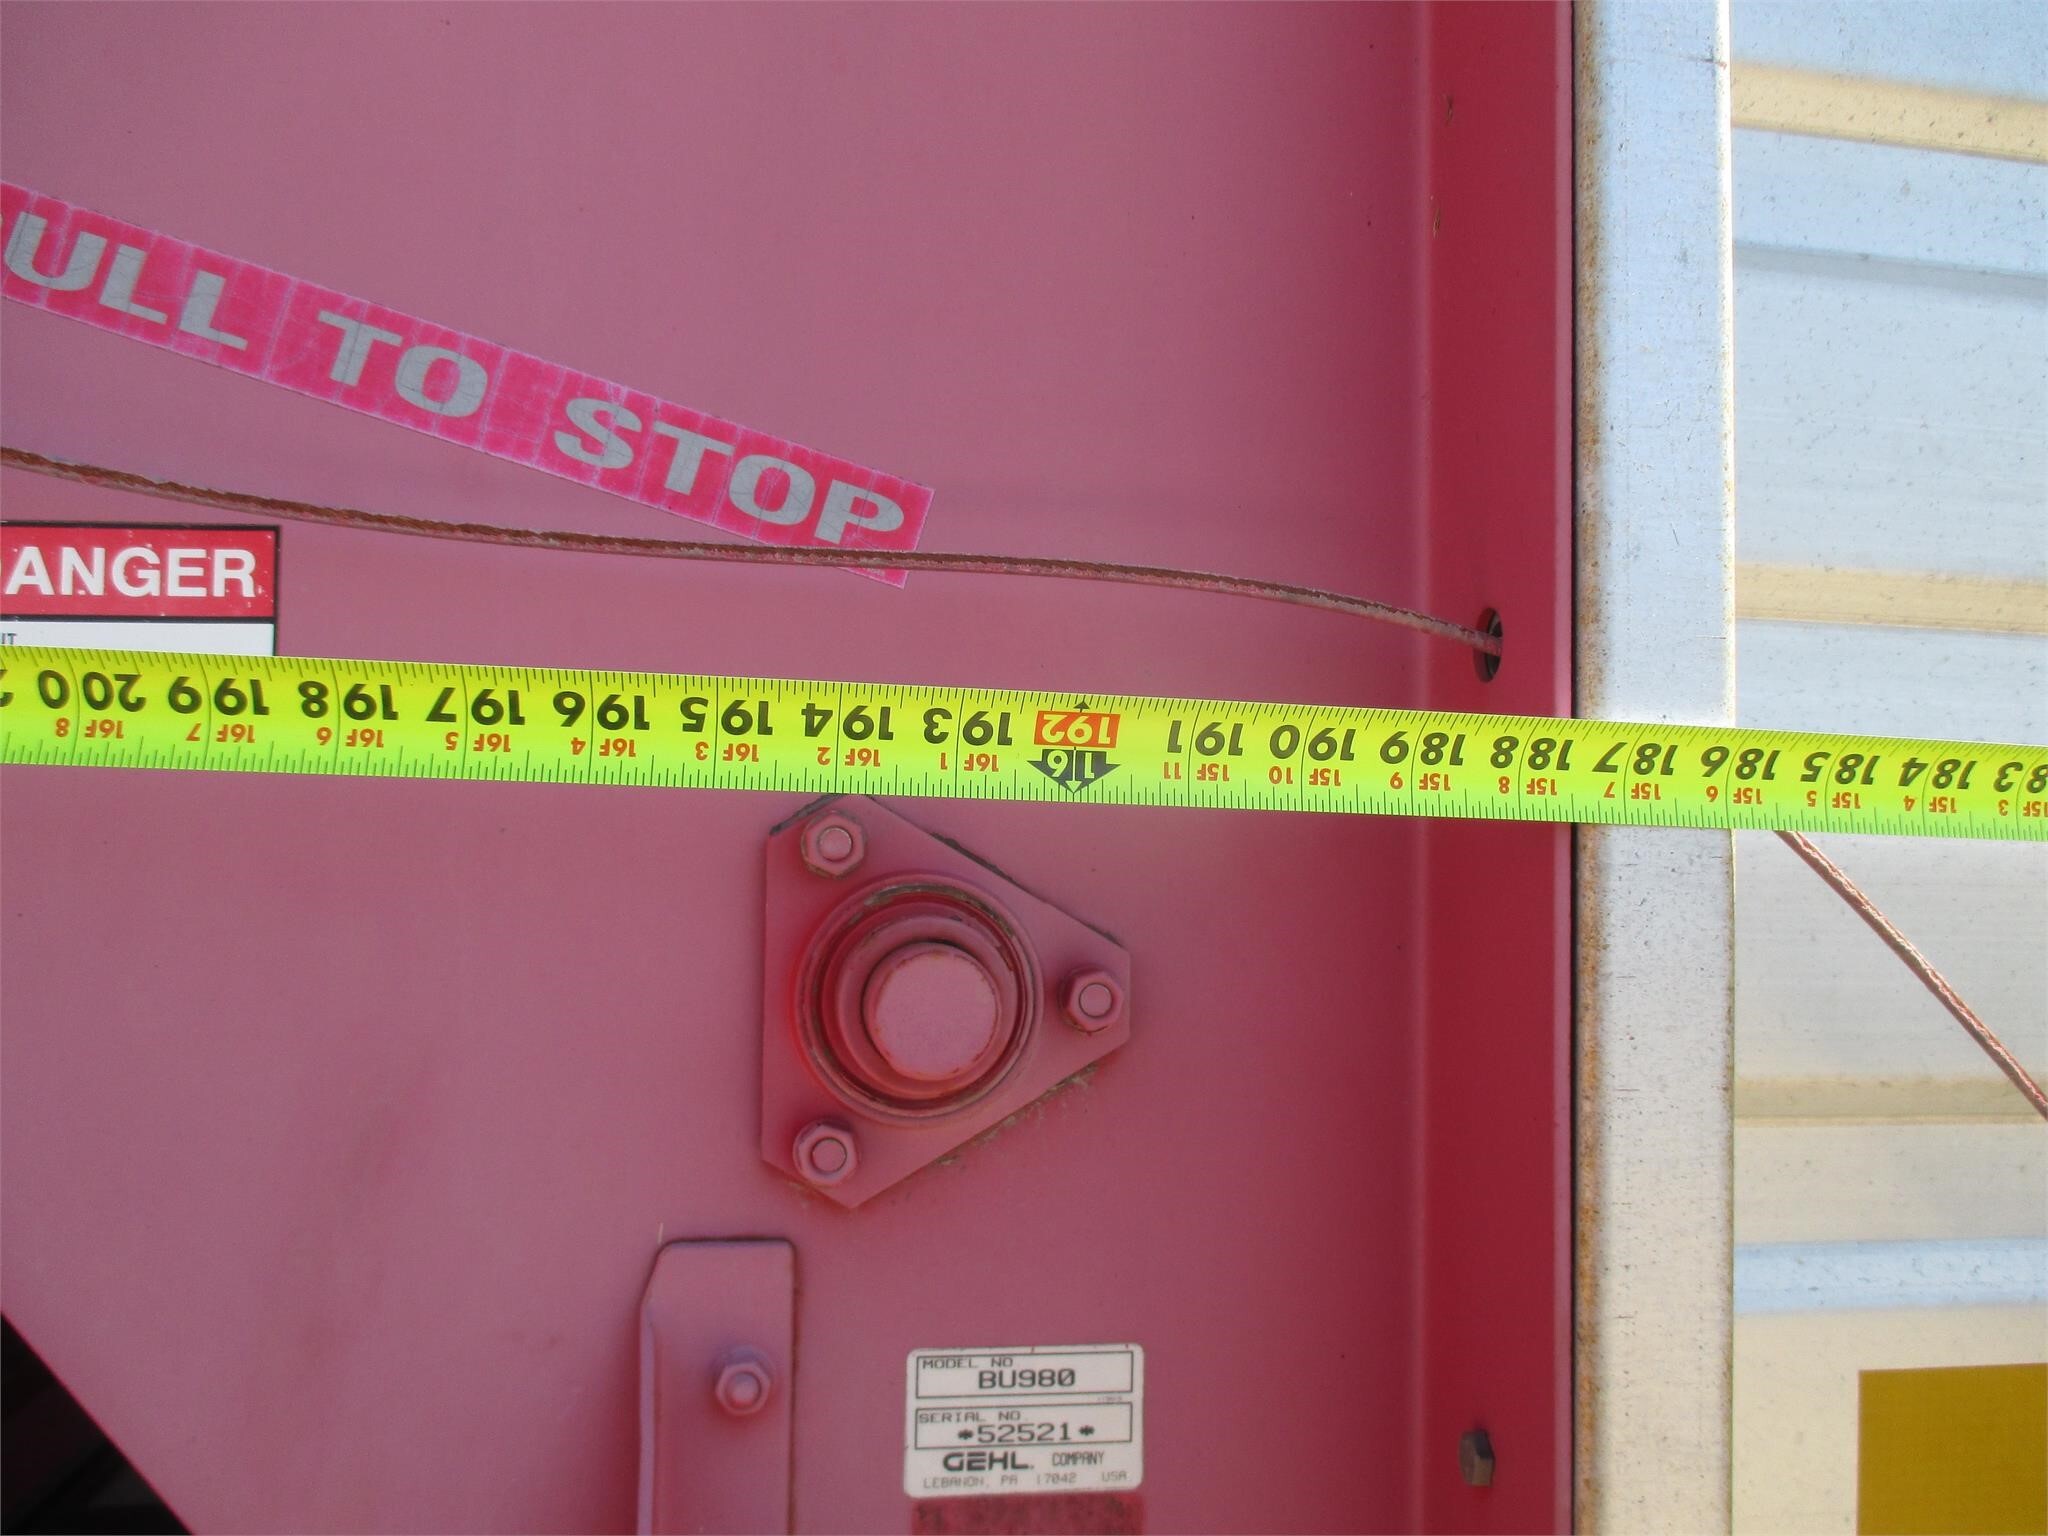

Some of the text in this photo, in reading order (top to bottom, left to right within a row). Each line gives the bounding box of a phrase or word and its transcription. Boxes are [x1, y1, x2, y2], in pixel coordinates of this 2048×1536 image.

[0, 211, 905, 544] ULL TO STOP
[0, 546, 256, 598] ANGER
[38, 669, 147, 712] 200
[168, 676, 270, 715] 199
[298, 680, 399, 720] 198
[425, 687, 525, 725] 197
[553, 691, 650, 730] 196
[680, 696, 773, 735] 195
[55, 717, 70, 738] 8
[84, 719, 124, 739] 16F
[801, 703, 894, 741] 194
[923, 707, 1013, 746] 193
[1041, 713, 1111, 745] 192
[186, 723, 202, 741] 7
[216, 723, 255, 743] 16F
[316, 726, 332, 745] 6
[345, 728, 384, 748] 16F
[445, 732, 459, 750] 5
[1167, 720, 1244, 756] 191
[473, 733, 511, 752] 16F
[571, 737, 586, 755] 4
[599, 738, 636, 757] 16F
[695, 741, 709, 760] 3
[1269, 724, 1356, 761] 190
[1379, 731, 1466, 766] 189
[722, 743, 759, 762] 16F
[817, 746, 831, 766] 2
[845, 748, 881, 767] 16F
[940, 752, 948, 770] 1
[1490, 735, 1574, 771] 188
[1592, 742, 1678, 775] 187
[963, 753, 999, 772] 16F
[1047, 750, 1095, 779] 16
[1163, 761, 1181, 780] 11
[1700, 746, 1781, 780] 186
[1800, 751, 1881, 785] 185
[1197, 763, 1230, 782] 15F
[1268, 765, 1293, 785] 10
[1308, 768, 1341, 787] 15F
[1390, 772, 1403, 789] 9
[1418, 773, 1450, 791] 15F
[1898, 757, 1977, 790] 184
[1993, 761, 2048, 794] 83
[1498, 776, 1510, 794] 8
[1526, 778, 1557, 796] 15F
[1604, 781, 1616, 798] 7
[1631, 782, 1661, 800] 15F
[1706, 786, 1718, 802] 6
[1733, 787, 1762, 805] 15F
[1806, 790, 1818, 807] 5
[1832, 792, 1861, 809] 15F
[1904, 795, 1916, 811] 4
[1929, 796, 1957, 814] 15F
[1998, 799, 2009, 816] 3
[922, 1358, 979, 1370] MODEL
[978, 1368, 1076, 1390] BU980
[919, 1411, 986, 1424] SERIAL
[1052, 1451, 1105, 1466] COMPANY
[1001, 1475, 1018, 1486] PA
[1036, 1472, 1077, 1485] 17042
